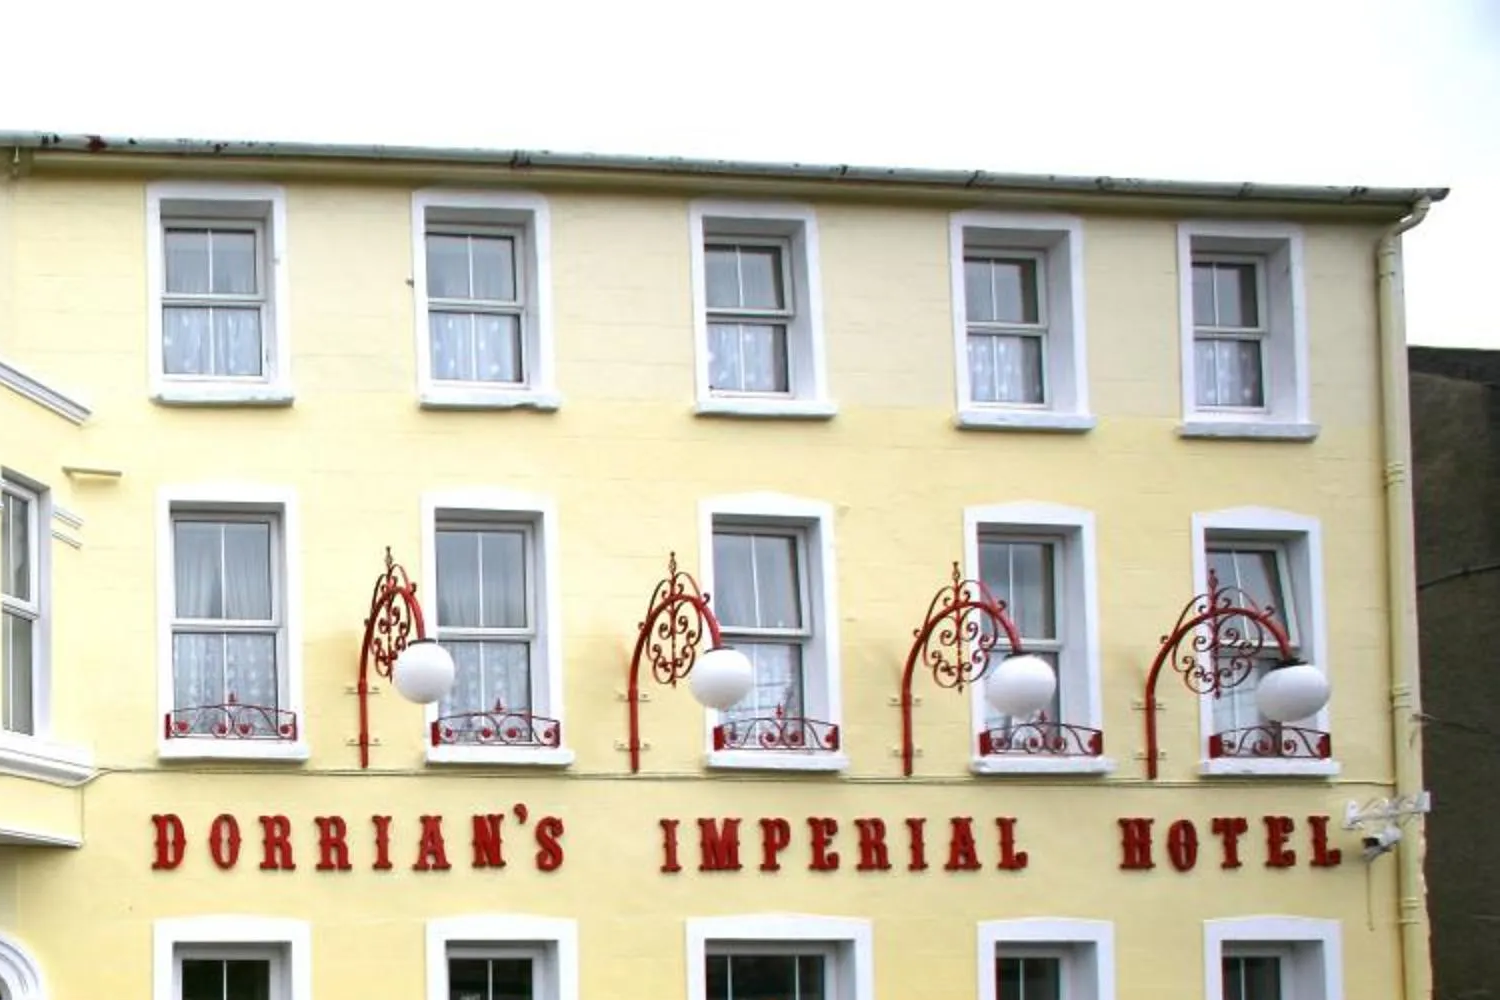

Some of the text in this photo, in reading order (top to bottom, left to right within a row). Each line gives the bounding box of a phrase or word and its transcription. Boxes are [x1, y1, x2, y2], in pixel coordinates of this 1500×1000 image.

[151, 803, 1344, 873] DORRIAN'S IMPERIAL HOTEL
